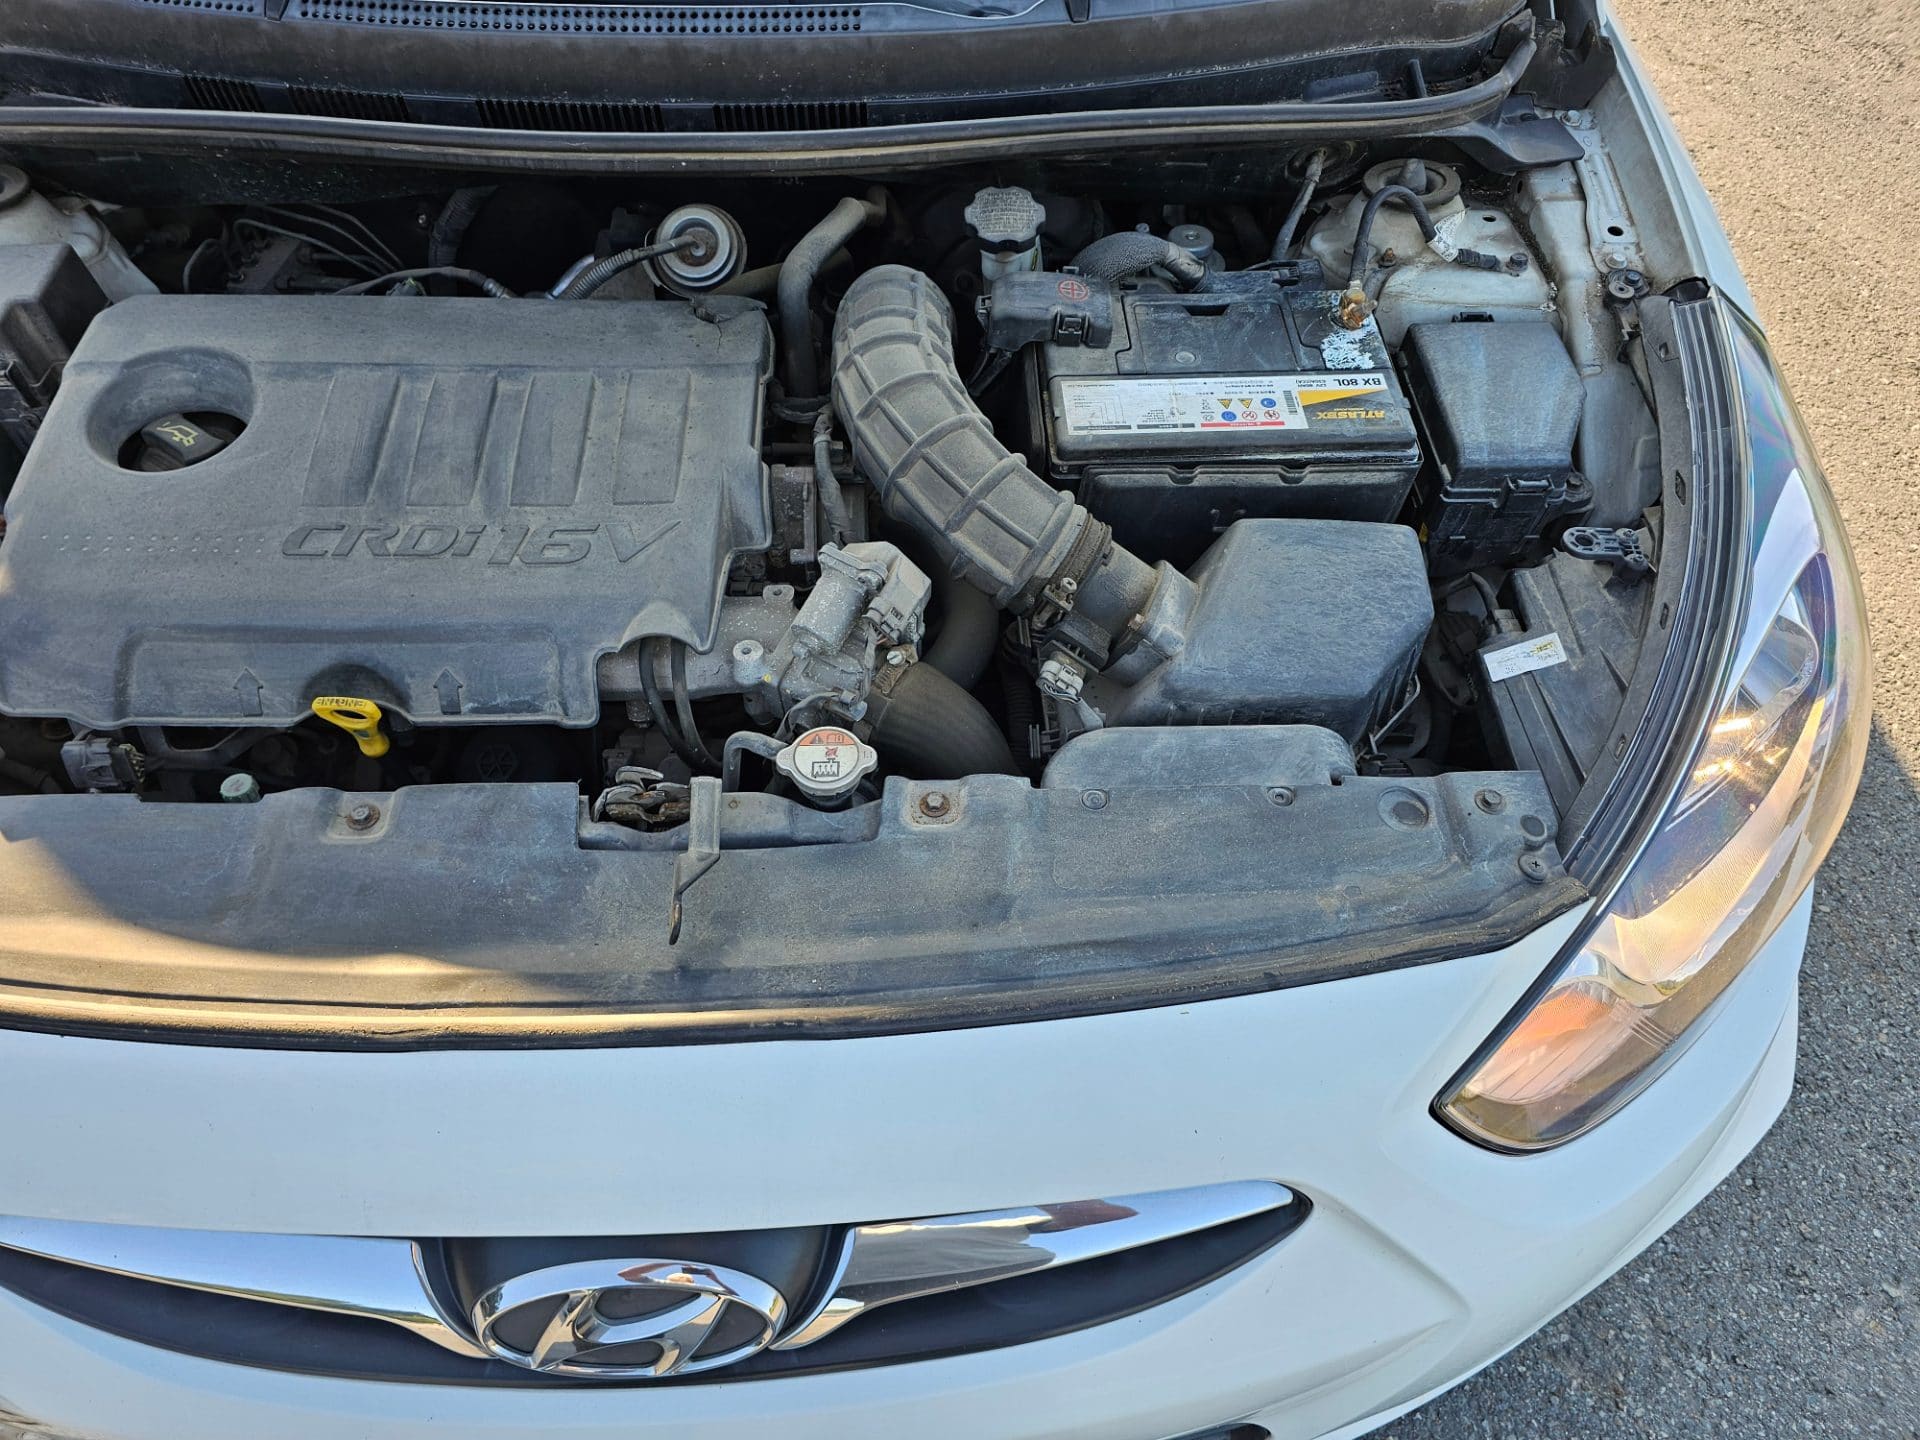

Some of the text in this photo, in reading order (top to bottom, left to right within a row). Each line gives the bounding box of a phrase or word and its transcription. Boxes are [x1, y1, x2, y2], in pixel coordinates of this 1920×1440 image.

[1334, 378, 1382, 387] BX 80L
[1317, 410, 1385, 419] ATLASBX
[281, 523, 488, 558] CRDi
